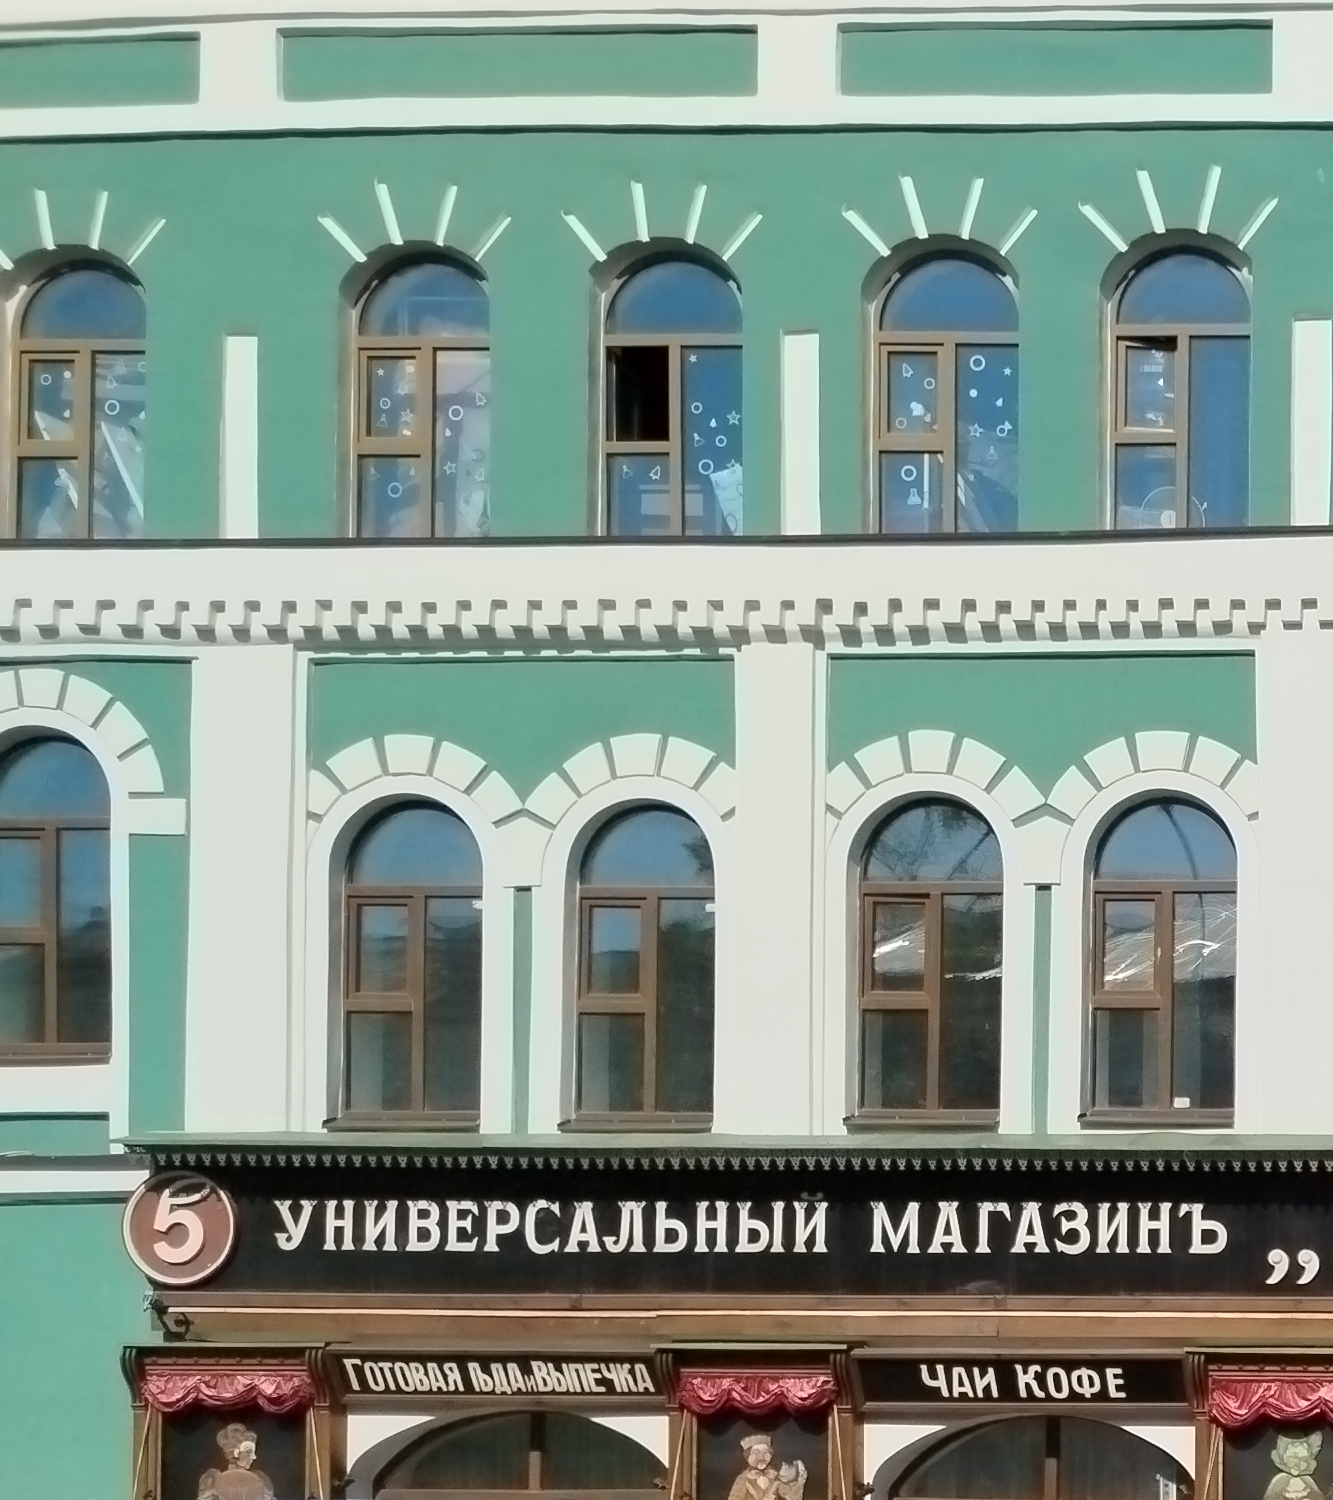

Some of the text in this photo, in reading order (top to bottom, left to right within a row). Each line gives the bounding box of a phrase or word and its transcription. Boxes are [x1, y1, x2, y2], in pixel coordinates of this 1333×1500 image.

[153, 1177, 209, 1264] 5
[273, 1191, 829, 1255] УНИВЕРСАЛЬНЫЙ
[869, 1200, 1229, 1256] МАГАЗИНЪ
[1014, 1363, 1127, 1399] КОФЕ
